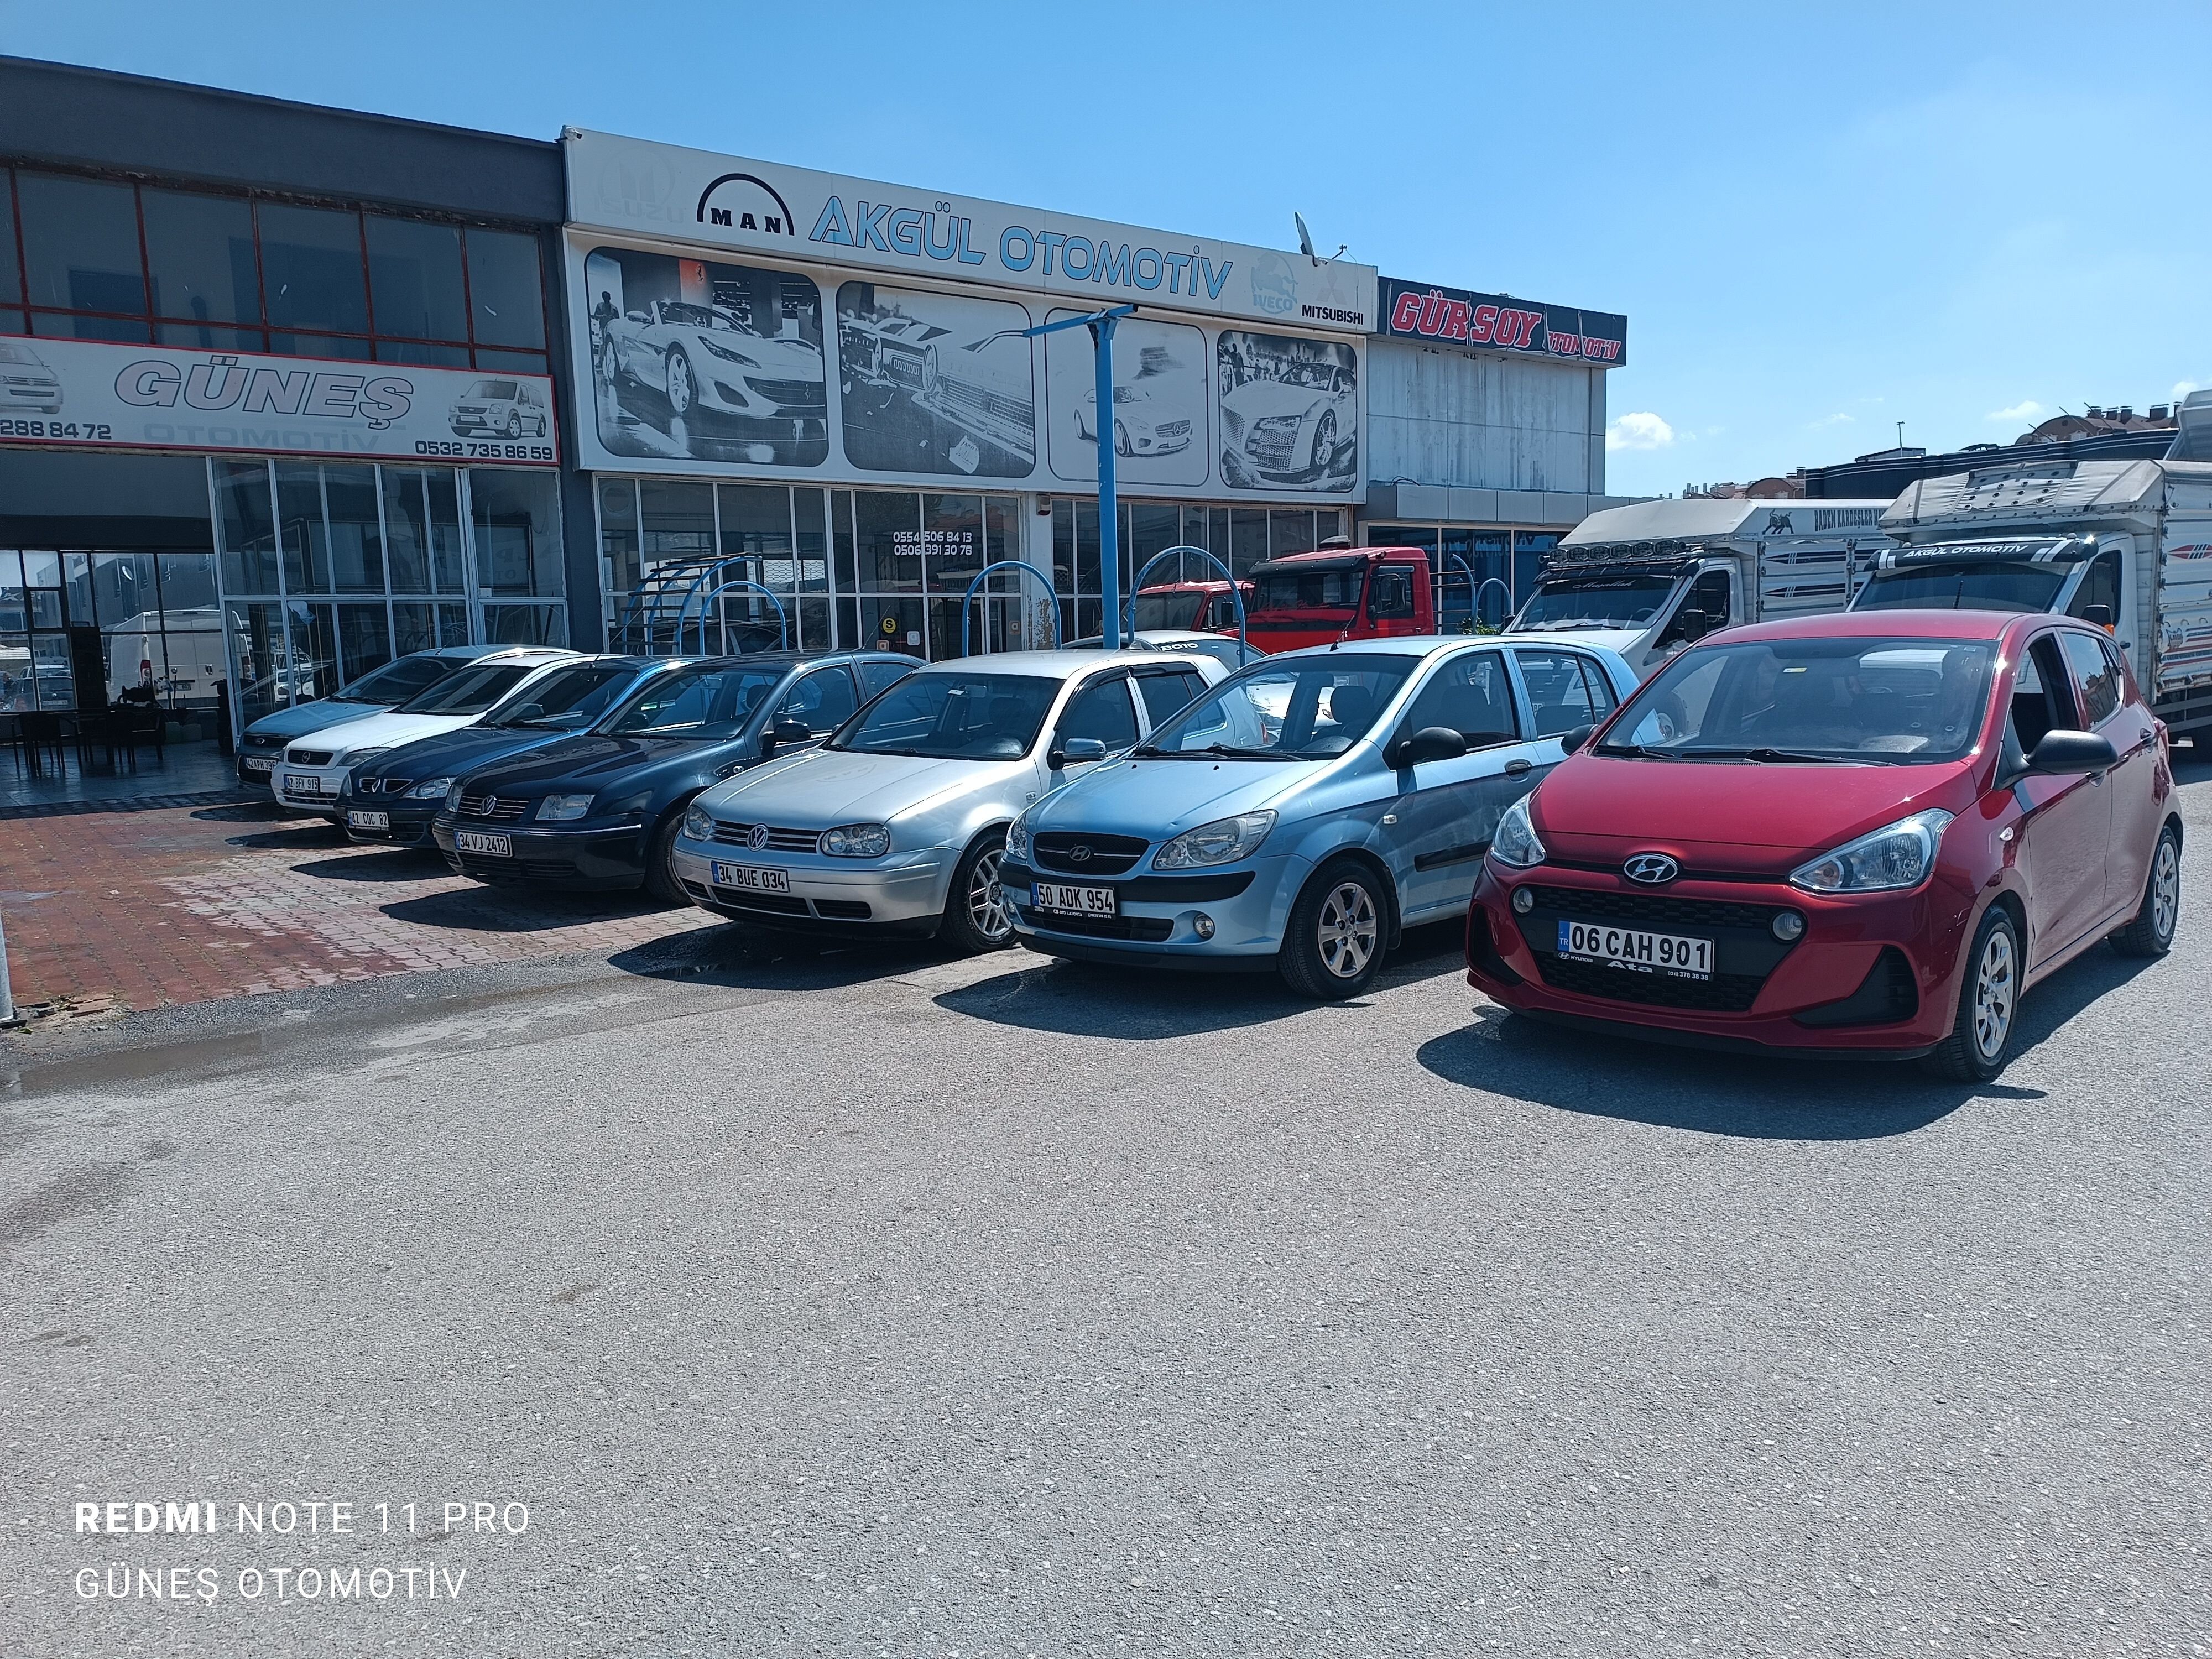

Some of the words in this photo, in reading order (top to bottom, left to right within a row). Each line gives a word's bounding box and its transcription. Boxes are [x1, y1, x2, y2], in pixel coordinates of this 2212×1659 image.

[710, 207, 781, 234] MAN
[808, 200, 987, 265] AKGÜL
[999, 226, 1233, 300] OTOMOTİV
[1253, 294, 1293, 311] IVECO
[1302, 304, 1364, 325] MITSUBISHI
[1391, 289, 1543, 348] GÜRSOY
[114, 355, 414, 430] GÜNEŞ
[0, 419, 44, 436] 288
[49, 422, 79, 438] 84
[82, 424, 112, 440] 72
[143, 423, 382, 452] OTOMOTİV
[415, 441, 463, 456] 0532
[467, 443, 501, 458] 735
[505, 445, 527, 459] 86
[530, 446, 552, 460] 59
[893, 531, 920, 542] 0554
[924, 531, 944, 542] 506
[946, 531, 960, 542] 84
[963, 532, 972, 542] 13
[894, 545, 921, 556] 0506
[925, 544, 942, 555] 391
[944, 544, 957, 555] 30
[960, 545, 972, 556] 78
[1903, 547, 1947, 558] AKGÜL
[1951, 544, 2028, 554] OTOMOTİV
[1161, 643, 1198, 651] 2010
[254, 760, 264, 769] APH
[307, 779, 317, 790] 915
[352, 812, 359, 823] 42
[379, 813, 388, 825] 82
[460, 834, 470, 848] 34
[471, 835, 483, 850] VJ
[486, 837, 507, 852] 2412
[719, 866, 732, 883] 34
[737, 868, 759, 886] BUE
[762, 871, 785, 889] 034
[1038, 885, 1053, 905] 50
[1059, 888, 1083, 909] ADK
[1087, 890, 1113, 911] 954
[1572, 926, 1600, 953] 06
[1606, 931, 1653, 962] CAH
[1659, 938, 1706, 969] 901
[1607, 961, 1653, 973] Ata
